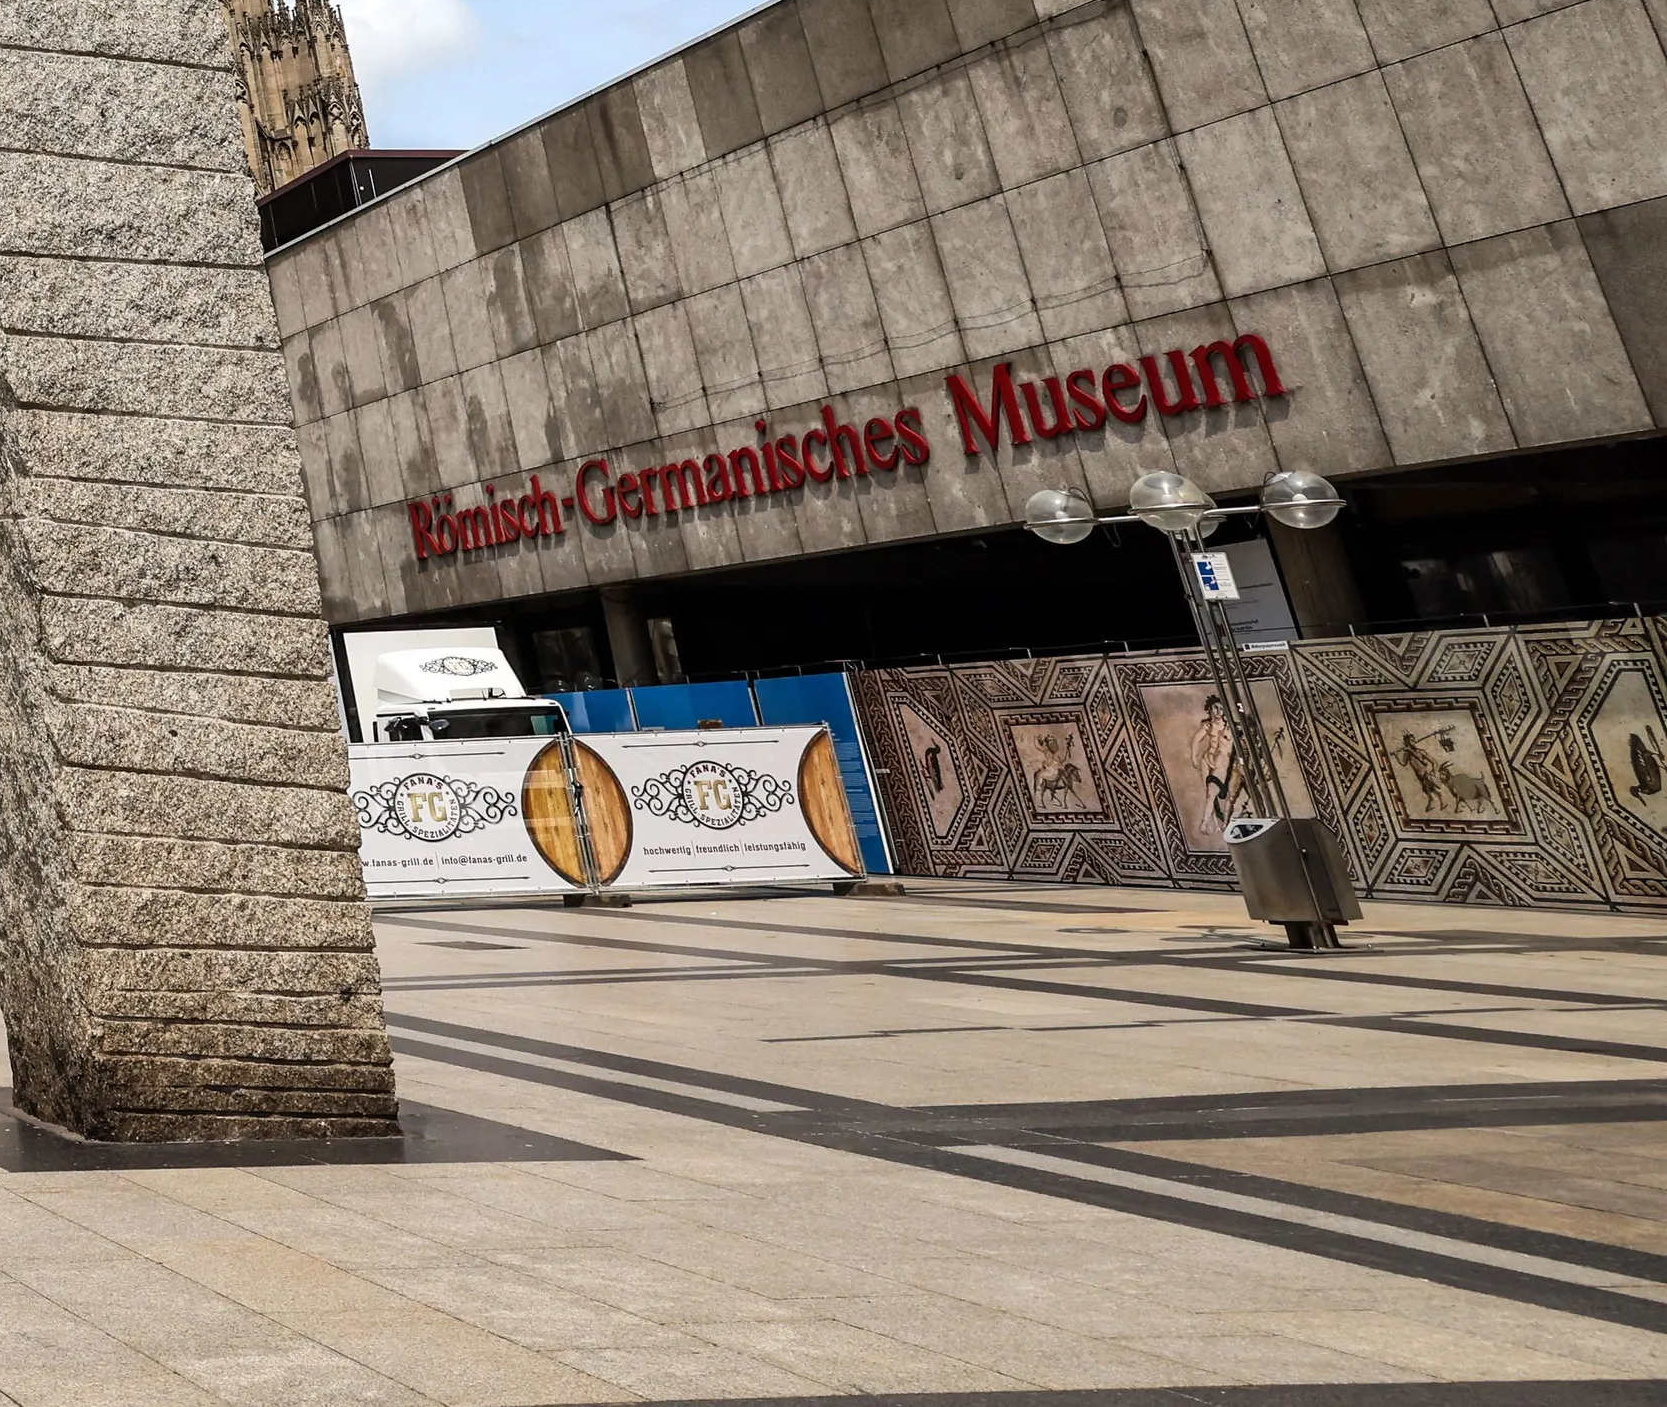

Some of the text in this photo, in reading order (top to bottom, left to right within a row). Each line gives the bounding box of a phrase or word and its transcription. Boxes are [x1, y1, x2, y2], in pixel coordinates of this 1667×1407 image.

[407, 331, 1290, 560] Römisch-Germanisches Museum
[690, 764, 726, 778] FANA'S
[403, 776, 443, 791] FANA'S
[694, 779, 732, 811] FG
[407, 791, 447, 823] FG
[643, 841, 806, 856] hochwertig freundlich leistungsfähig
[361, 854, 528, 868] w.fanas-grill.de info@fanas-grill.de
